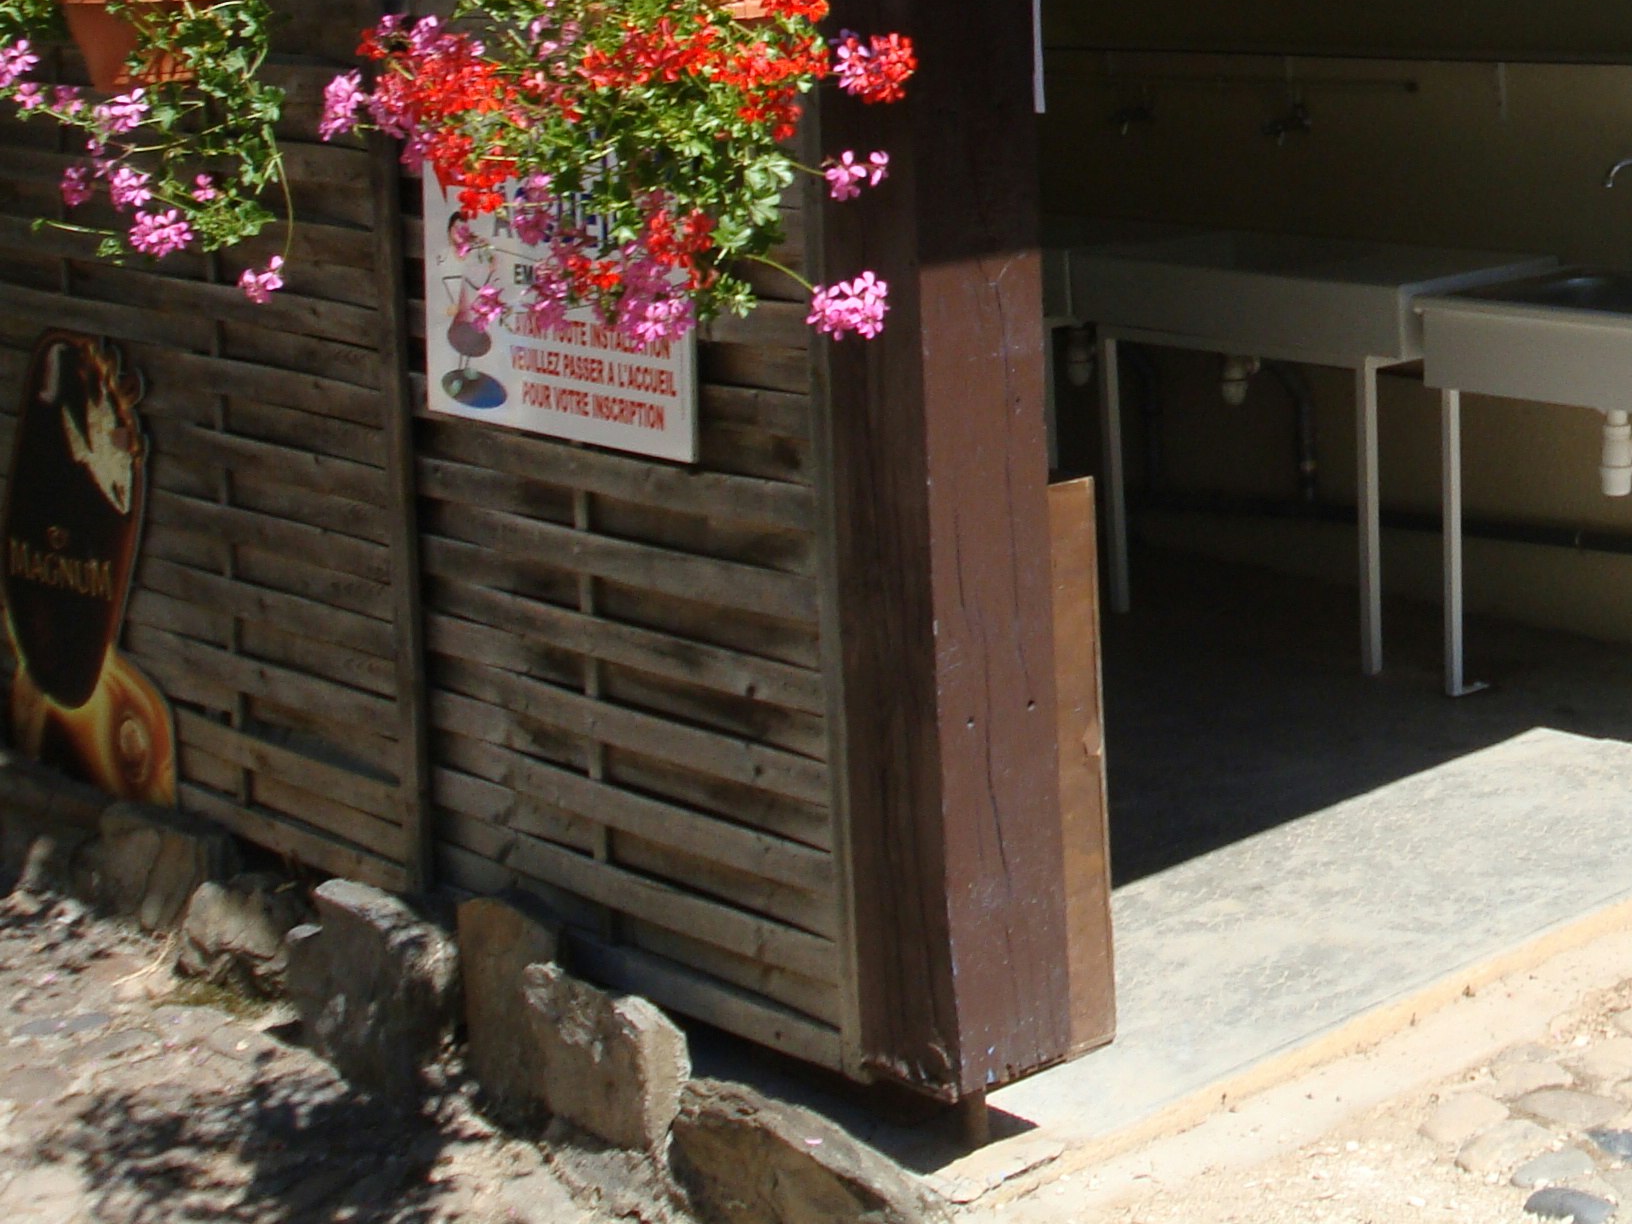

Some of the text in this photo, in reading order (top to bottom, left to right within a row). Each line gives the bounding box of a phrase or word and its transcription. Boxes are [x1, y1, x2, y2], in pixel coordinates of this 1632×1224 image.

[563, 353, 604, 384] PASSER
[607, 361, 615, 386] A
[618, 363, 677, 397] L'ACCUEIL
[522, 381, 665, 431] POUR VOTRE INSCRIPTION
[9, 539, 112, 601] MAGNUM
